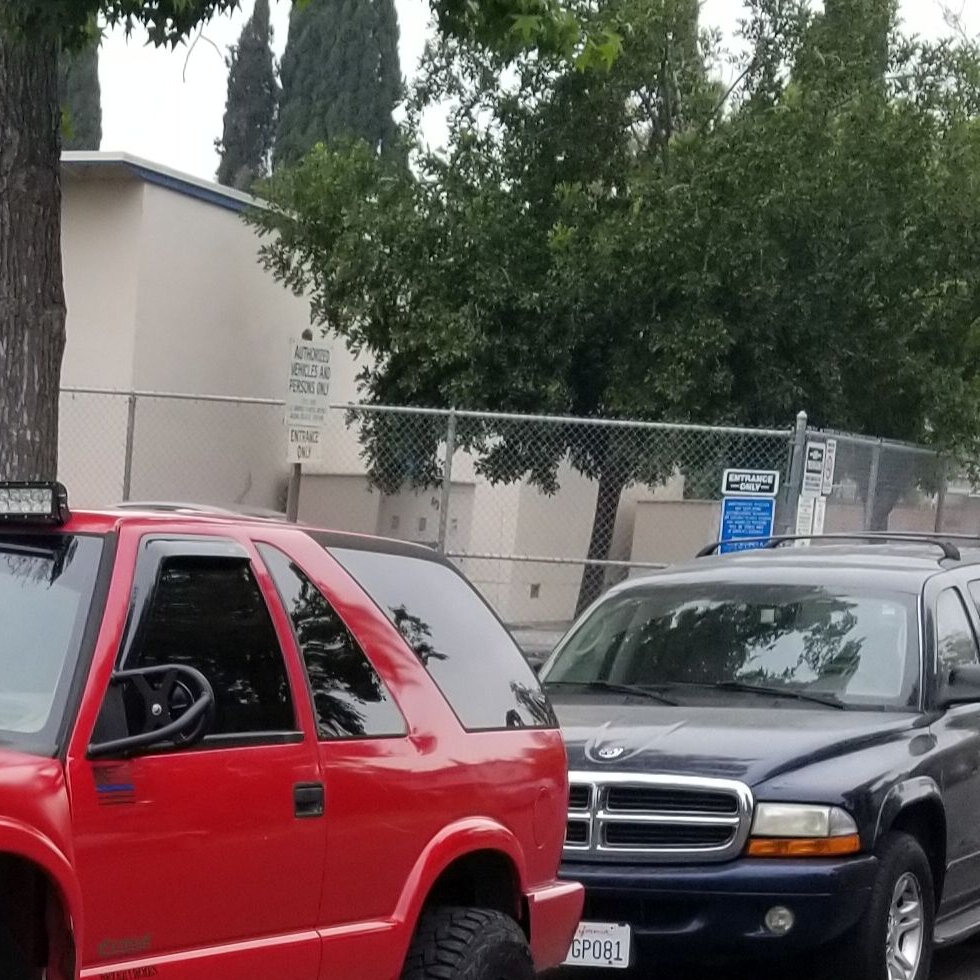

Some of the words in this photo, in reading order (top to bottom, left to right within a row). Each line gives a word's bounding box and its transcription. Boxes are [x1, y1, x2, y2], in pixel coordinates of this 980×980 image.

[291, 362, 318, 378] VEHICLES
[289, 379, 316, 394] PERSONS
[317, 382, 330, 396] ONLY
[290, 429, 318, 443] ENTRANCE
[297, 445, 311, 459] ONLY
[728, 473, 774, 484] ENTRANCE
[739, 482, 762, 492] ONLY
